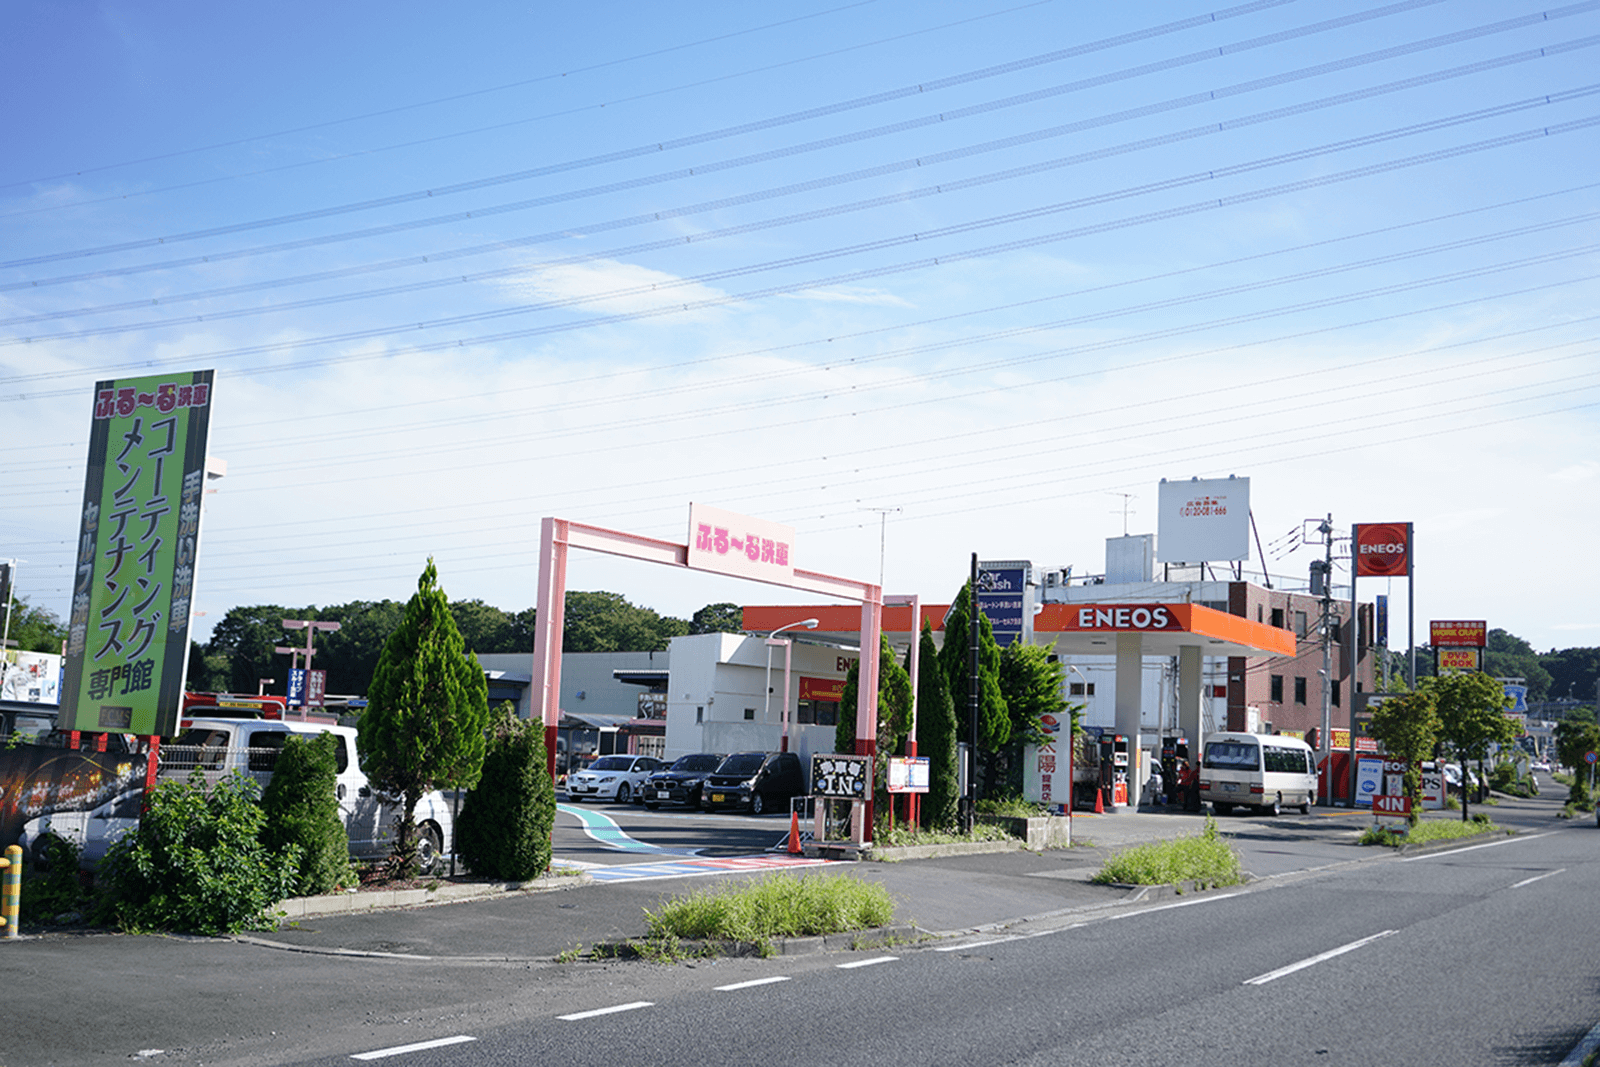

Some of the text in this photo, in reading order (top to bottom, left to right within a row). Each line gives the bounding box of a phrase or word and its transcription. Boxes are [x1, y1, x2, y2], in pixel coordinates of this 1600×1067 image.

[94, 417, 145, 662] メンテナンス
[126, 416, 178, 662] コーティング
[169, 469, 201, 633] 手洗い洗車
[1360, 543, 1404, 554] ENEOS
[68, 502, 99, 658] セルフ洗車
[1079, 607, 1168, 628] ENEOS
[87, 658, 155, 700] 専門館
[824, 775, 854, 795] IN
[1385, 797, 1405, 811] IN
